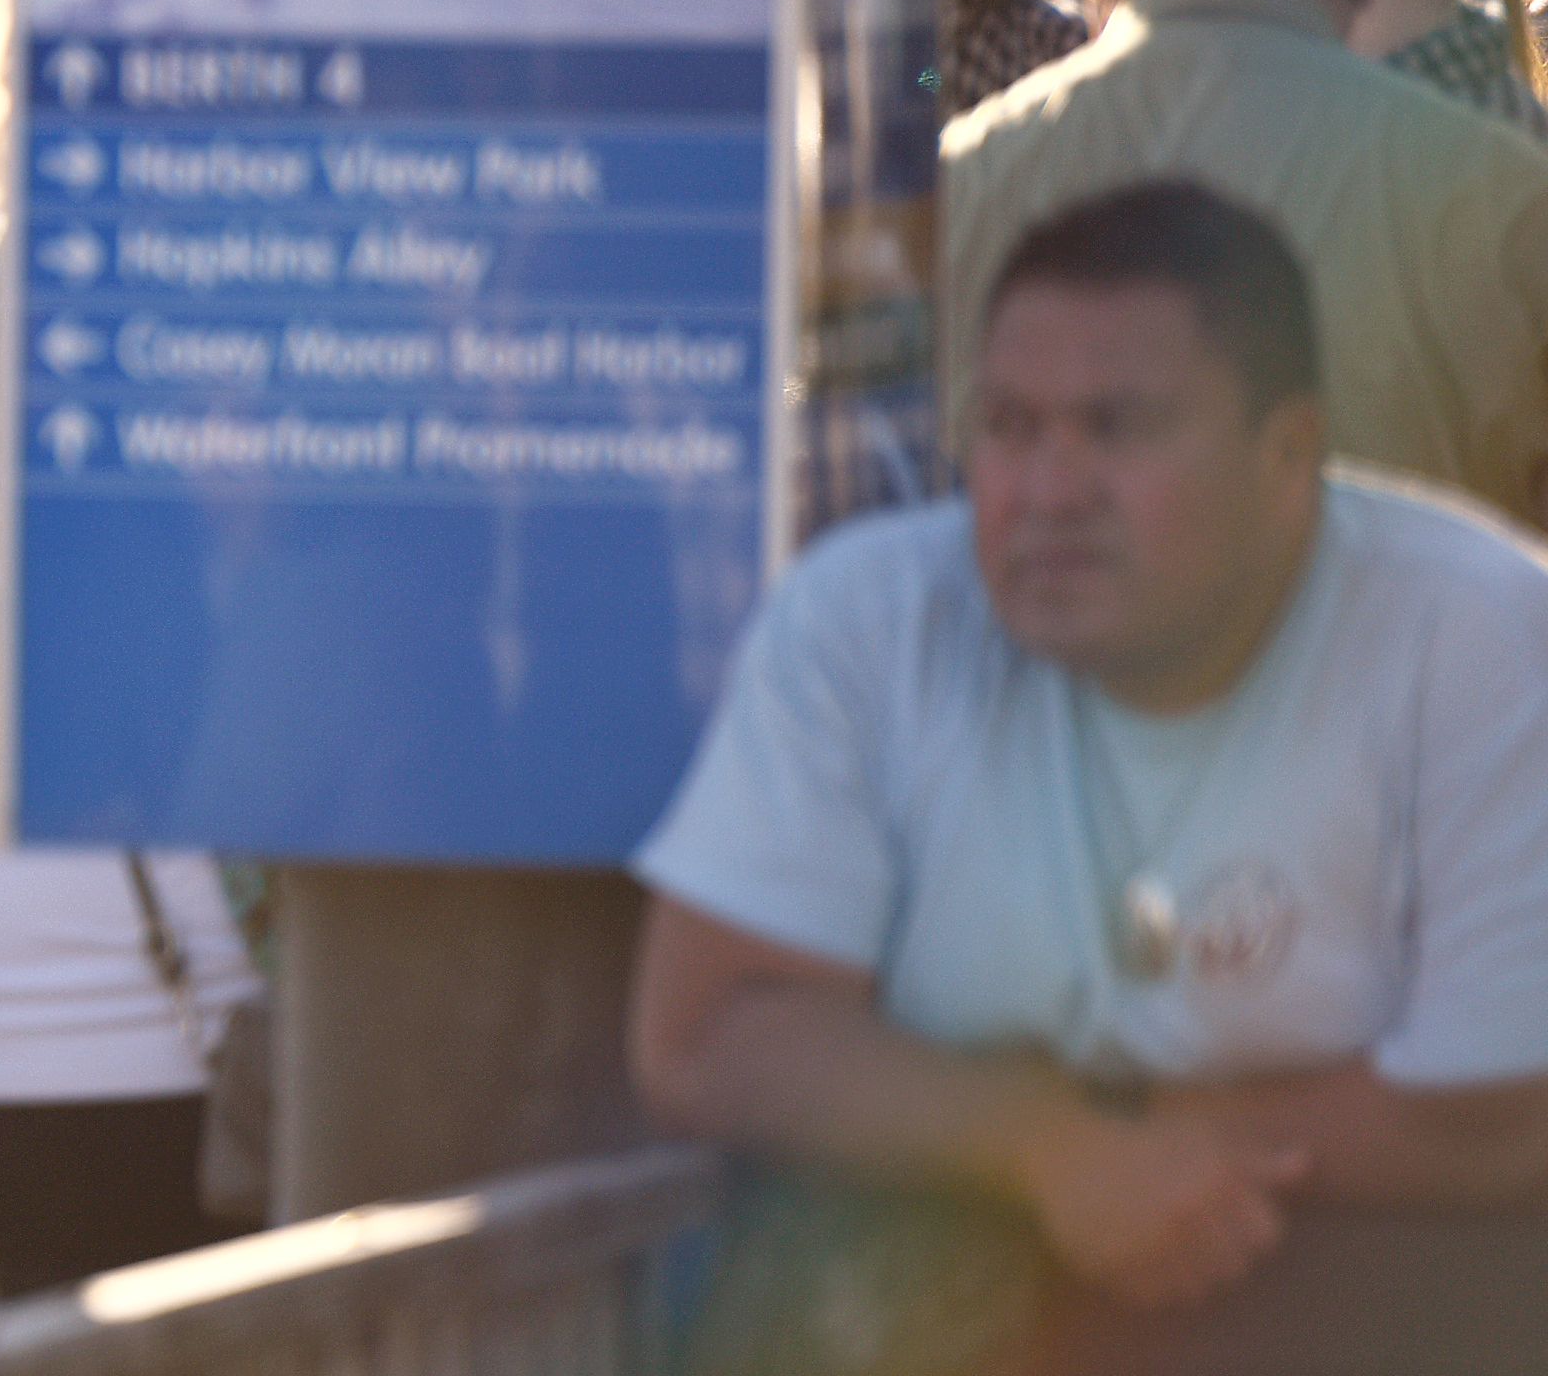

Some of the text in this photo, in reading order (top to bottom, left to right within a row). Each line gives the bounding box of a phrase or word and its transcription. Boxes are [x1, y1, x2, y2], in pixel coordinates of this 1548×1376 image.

[120, 49, 366, 107] BERTH 4
[118, 137, 603, 200] Harbor View Park
[118, 228, 493, 298] Hopkins Alley
[116, 319, 270, 390] Casey
[575, 324, 745, 382] Harbor
[120, 412, 743, 475] Waterfront Promenade
